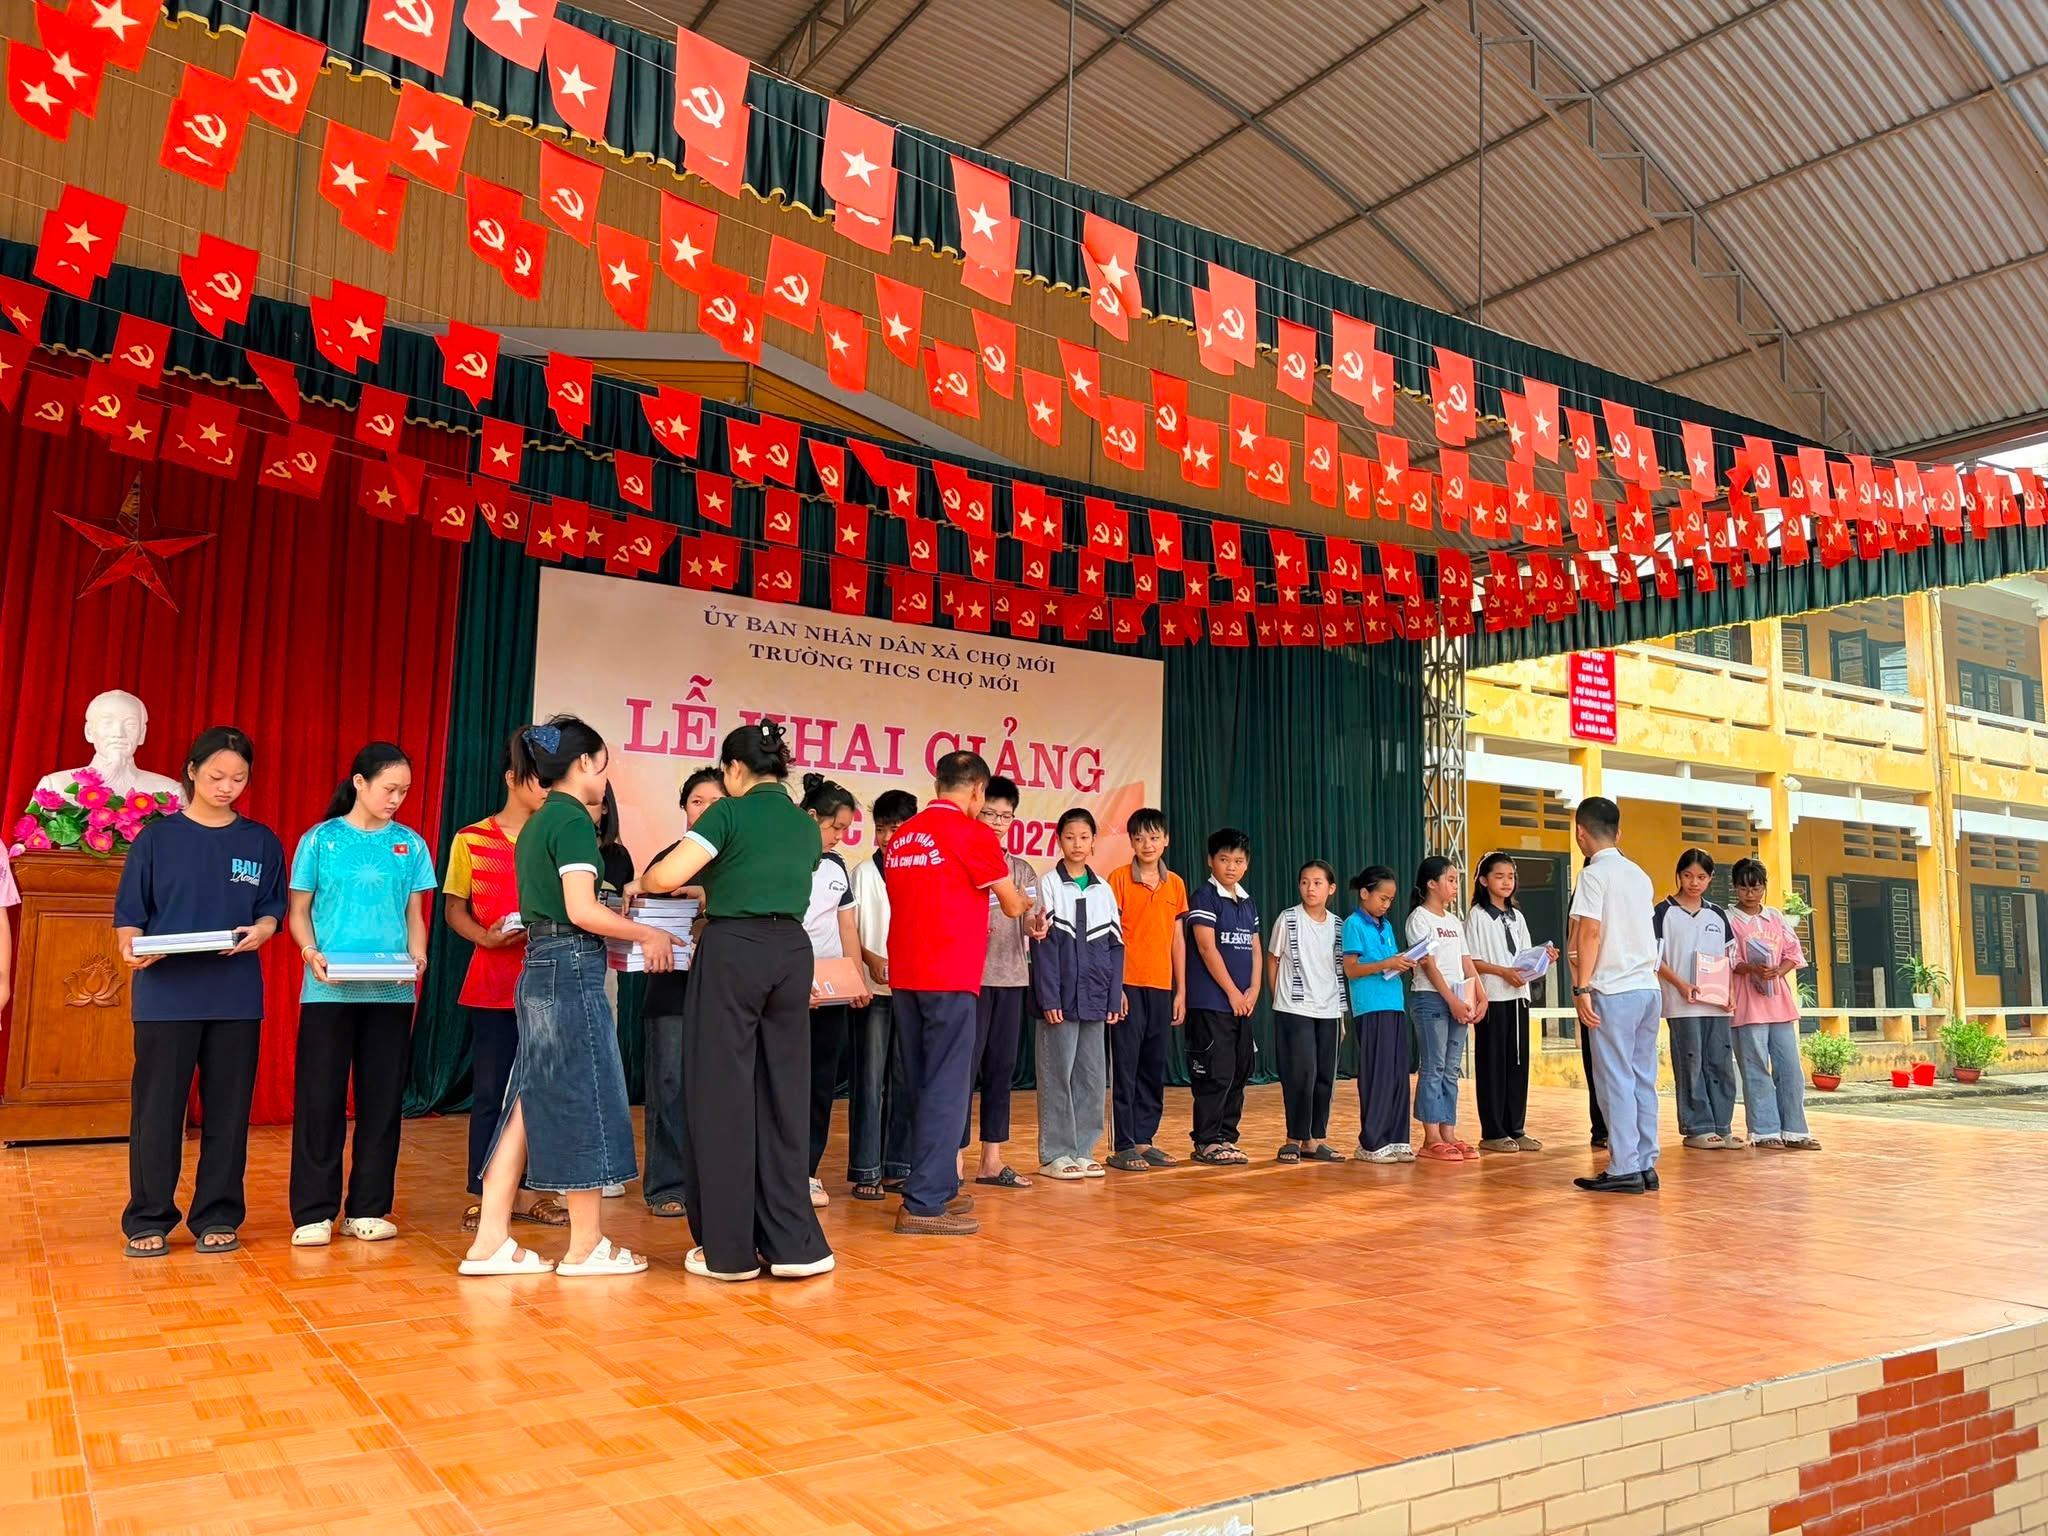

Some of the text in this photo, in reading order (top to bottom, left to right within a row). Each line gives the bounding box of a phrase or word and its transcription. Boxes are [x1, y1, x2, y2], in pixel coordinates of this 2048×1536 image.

[704, 605, 1056, 673] ỦY BAN NHÂN DÂN XÃ CHỢ MỚI
[749, 644, 1019, 692] TRƯỜNG THCS CHỢ MỚI
[624, 675, 716, 758] LỄ
[739, 711, 905, 775] HAI
